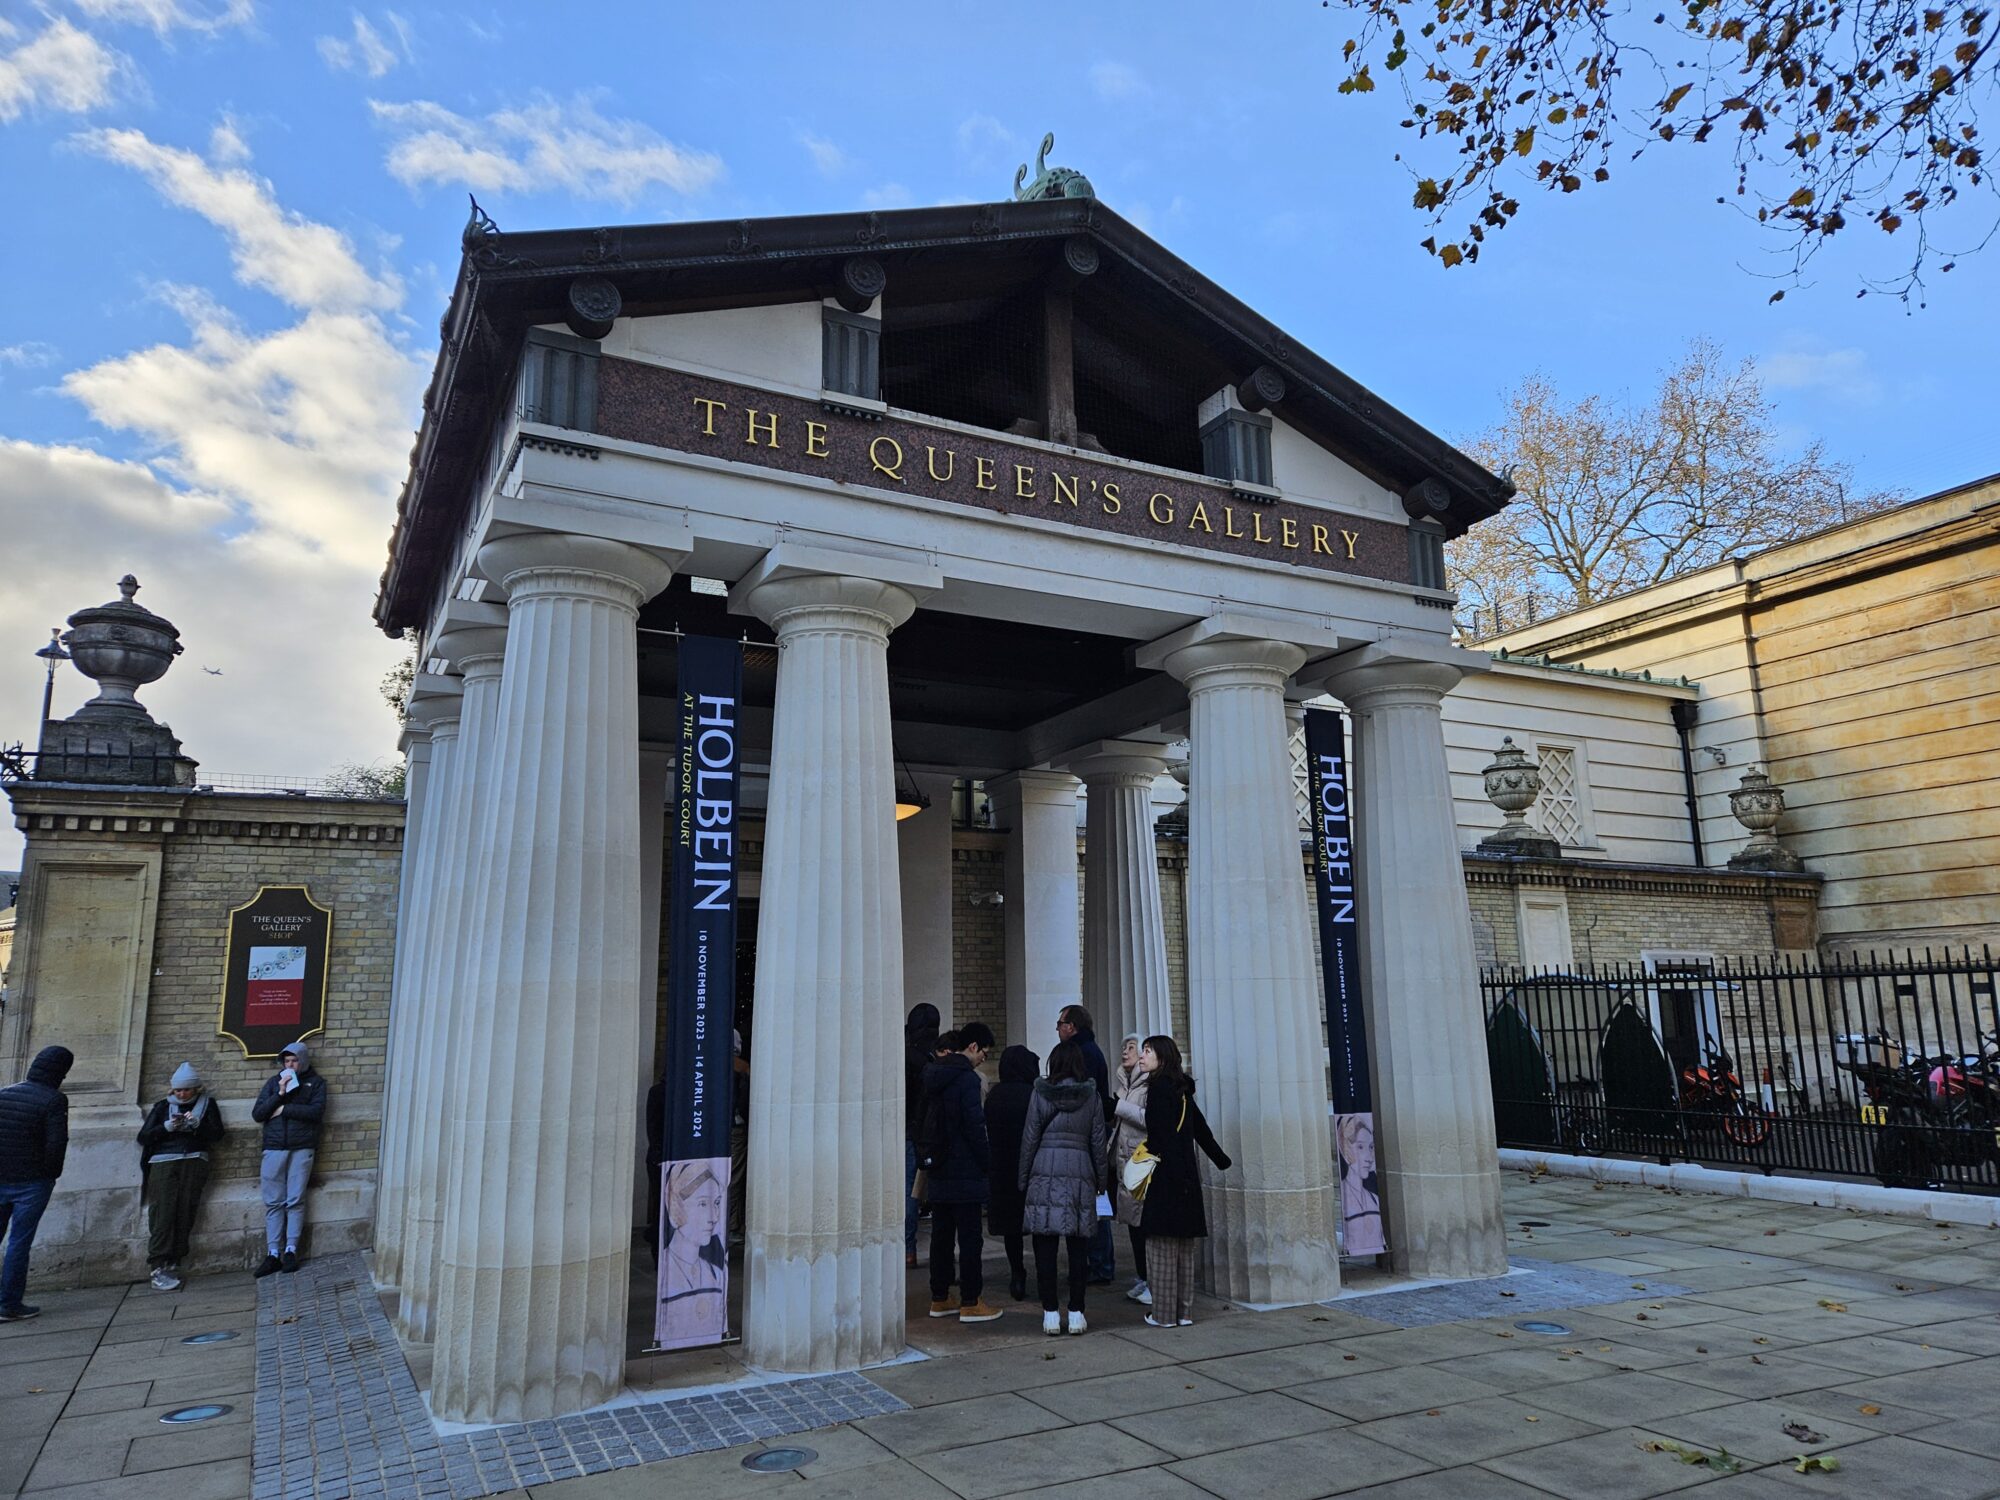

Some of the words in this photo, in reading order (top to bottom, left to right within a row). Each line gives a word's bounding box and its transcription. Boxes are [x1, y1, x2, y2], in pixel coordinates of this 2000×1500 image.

[694, 397, 830, 458] THE
[869, 436, 1121, 514] QUEEN'S
[1149, 493, 1359, 559] GALLERY
[684, 691, 694, 710] AT
[683, 716, 694, 740] THE
[681, 745, 693, 792] TUDOR
[693, 693, 735, 911] HOLBEIN
[680, 799, 690, 847] COURT
[1319, 754, 1355, 923] HOLBEIN
[1318, 838, 1328, 874] COURT
[252, 915, 271, 923] THE
[273, 916, 312, 924] QUEEN'S
[699, 930, 707, 941] 10
[696, 945, 707, 1010] NOVEMBER
[1337, 950, 1346, 999] NOVEMBER
[696, 1014, 705, 1040] 2023
[695, 1056, 704, 1067] 14
[694, 1071, 704, 1106] APRIL
[692, 1110, 702, 1138] 2024
